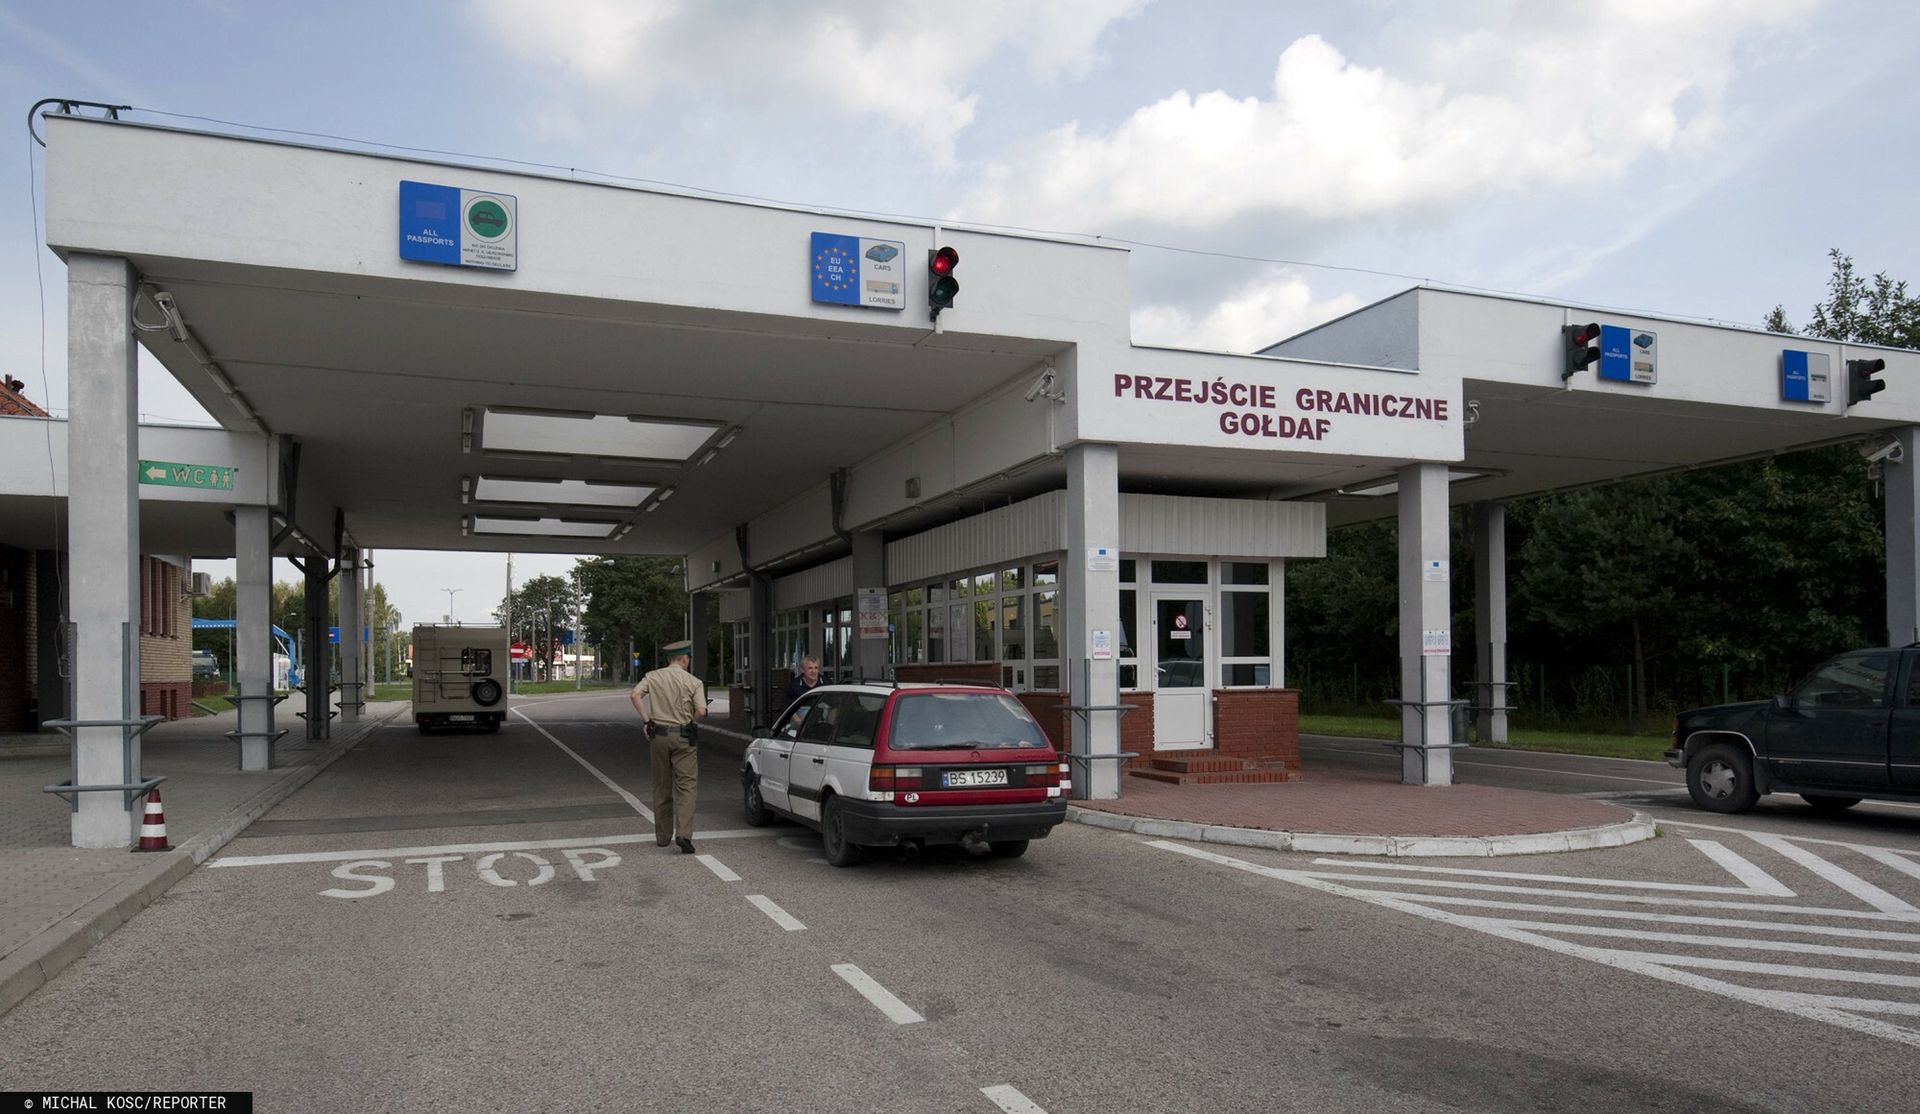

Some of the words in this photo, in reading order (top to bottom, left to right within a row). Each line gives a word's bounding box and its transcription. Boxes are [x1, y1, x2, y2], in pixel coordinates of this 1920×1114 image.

[423, 228, 438, 237] ALL
[407, 234, 454, 247] PASSPORTS
[830, 257, 841, 265] EU
[828, 265, 844, 273] EEA
[874, 264, 892, 272] CARS
[868, 296, 896, 306] LORRIES
[1114, 374, 1276, 409] PRZEJŚCIE
[1295, 388, 1449, 421] GRANICZNE
[172, 467, 205, 484] WC
[950, 772, 967, 785] BS
[971, 770, 1005, 785] 15239
[906, 793, 918, 801] PL
[319, 848, 622, 899] STOP
